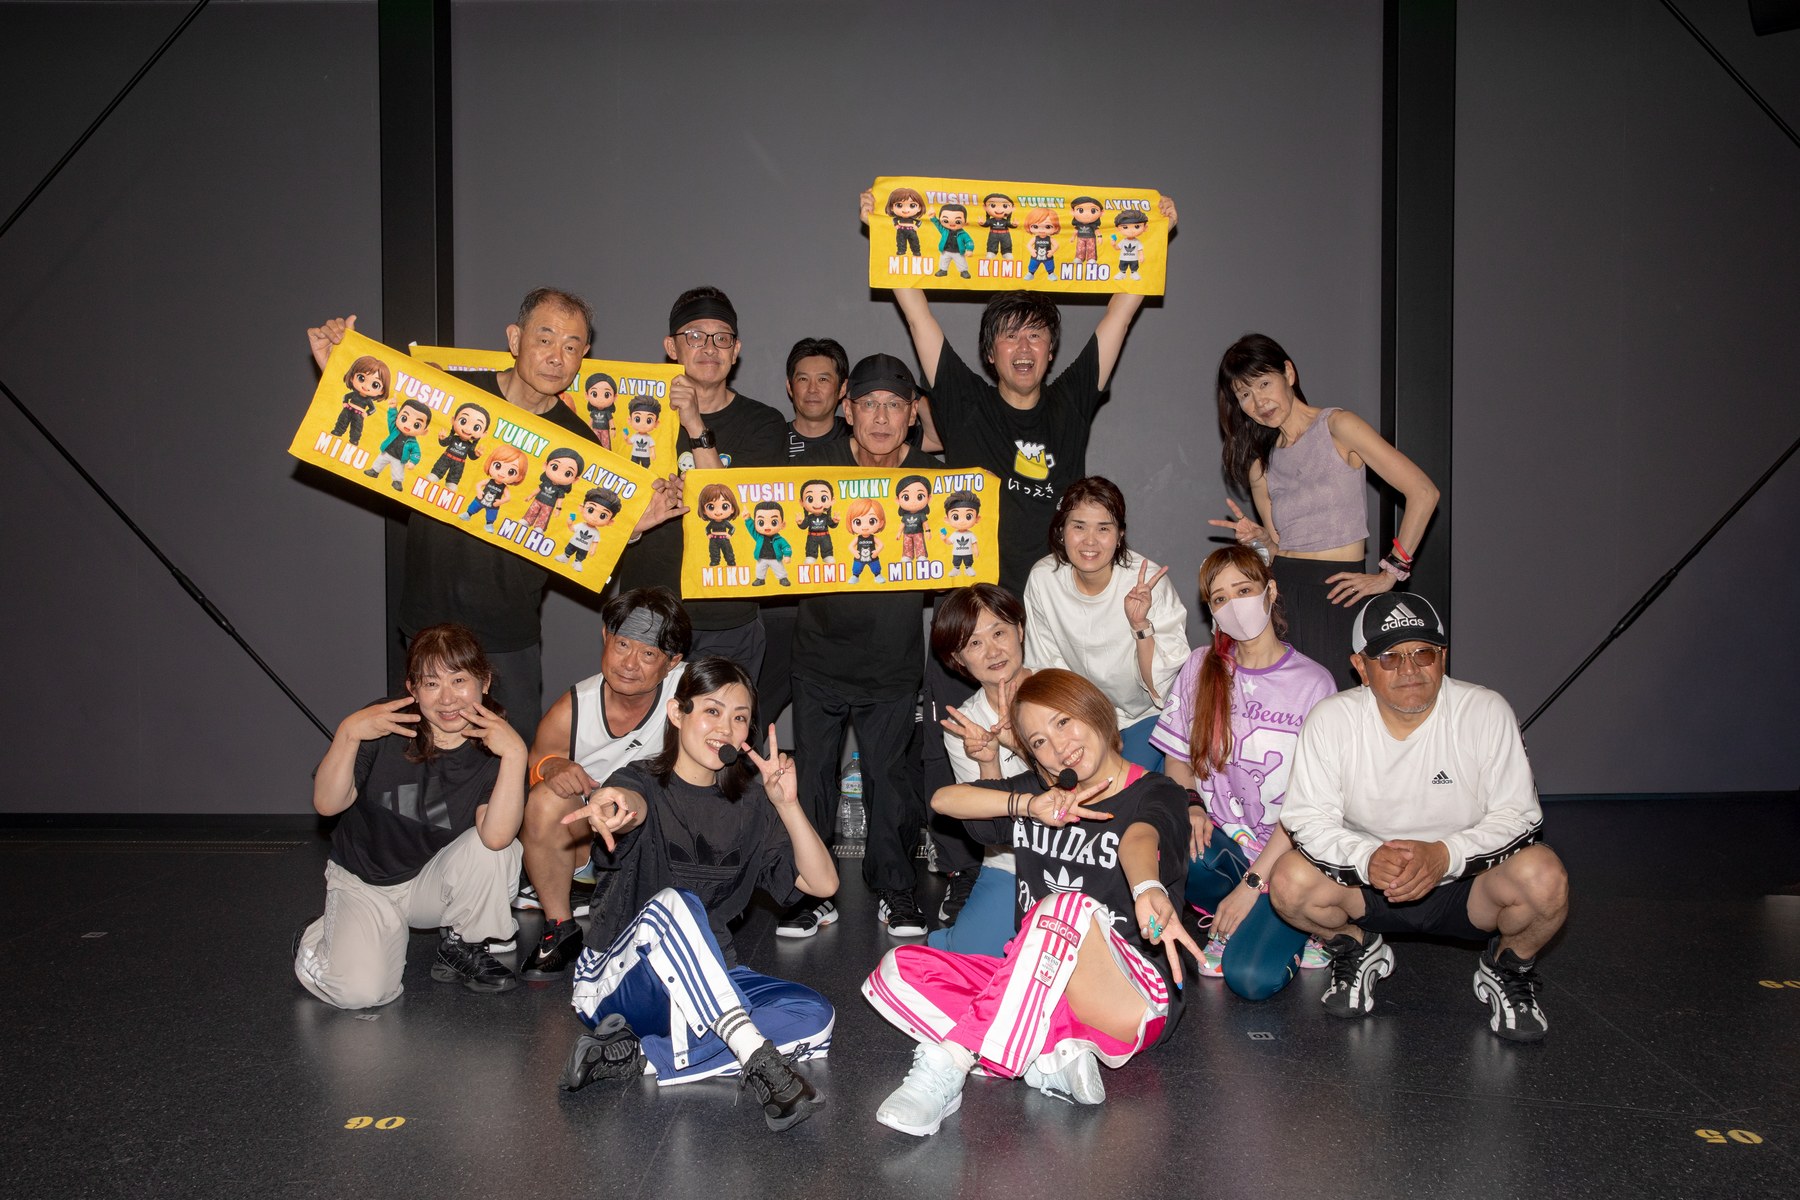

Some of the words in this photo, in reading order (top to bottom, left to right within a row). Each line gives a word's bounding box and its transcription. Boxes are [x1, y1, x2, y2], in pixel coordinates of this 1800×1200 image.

[925, 190, 979, 206] YUSHI
[1017, 195, 1066, 209] YUKKY
[1105, 198, 1151, 212] AYUTO
[888, 256, 934, 276] MIKU
[978, 259, 1023, 278] KIMI
[1060, 262, 1111, 281] MIHO
[617, 377, 666, 398] AYUTO
[393, 370, 455, 415] YUSHI
[493, 417, 550, 458] YUKKY
[581, 463, 638, 500] AYUTO
[313, 431, 370, 470] MIKU
[411, 476, 465, 514] KIMI
[497, 517, 556, 557] MIHO
[737, 482, 795, 503] YUSHI
[838, 478, 892, 499] YUKKY
[933, 473, 985, 494] AYUTO
[701, 566, 751, 587] MIKU
[797, 563, 847, 584] KIMI
[888, 560, 944, 582] MIHO
[1381, 616, 1425, 632] adidas
[1241, 700, 1304, 728] Bears
[1013, 816, 1120, 870] ADIDAS
[1040, 919, 1079, 946] adidas
